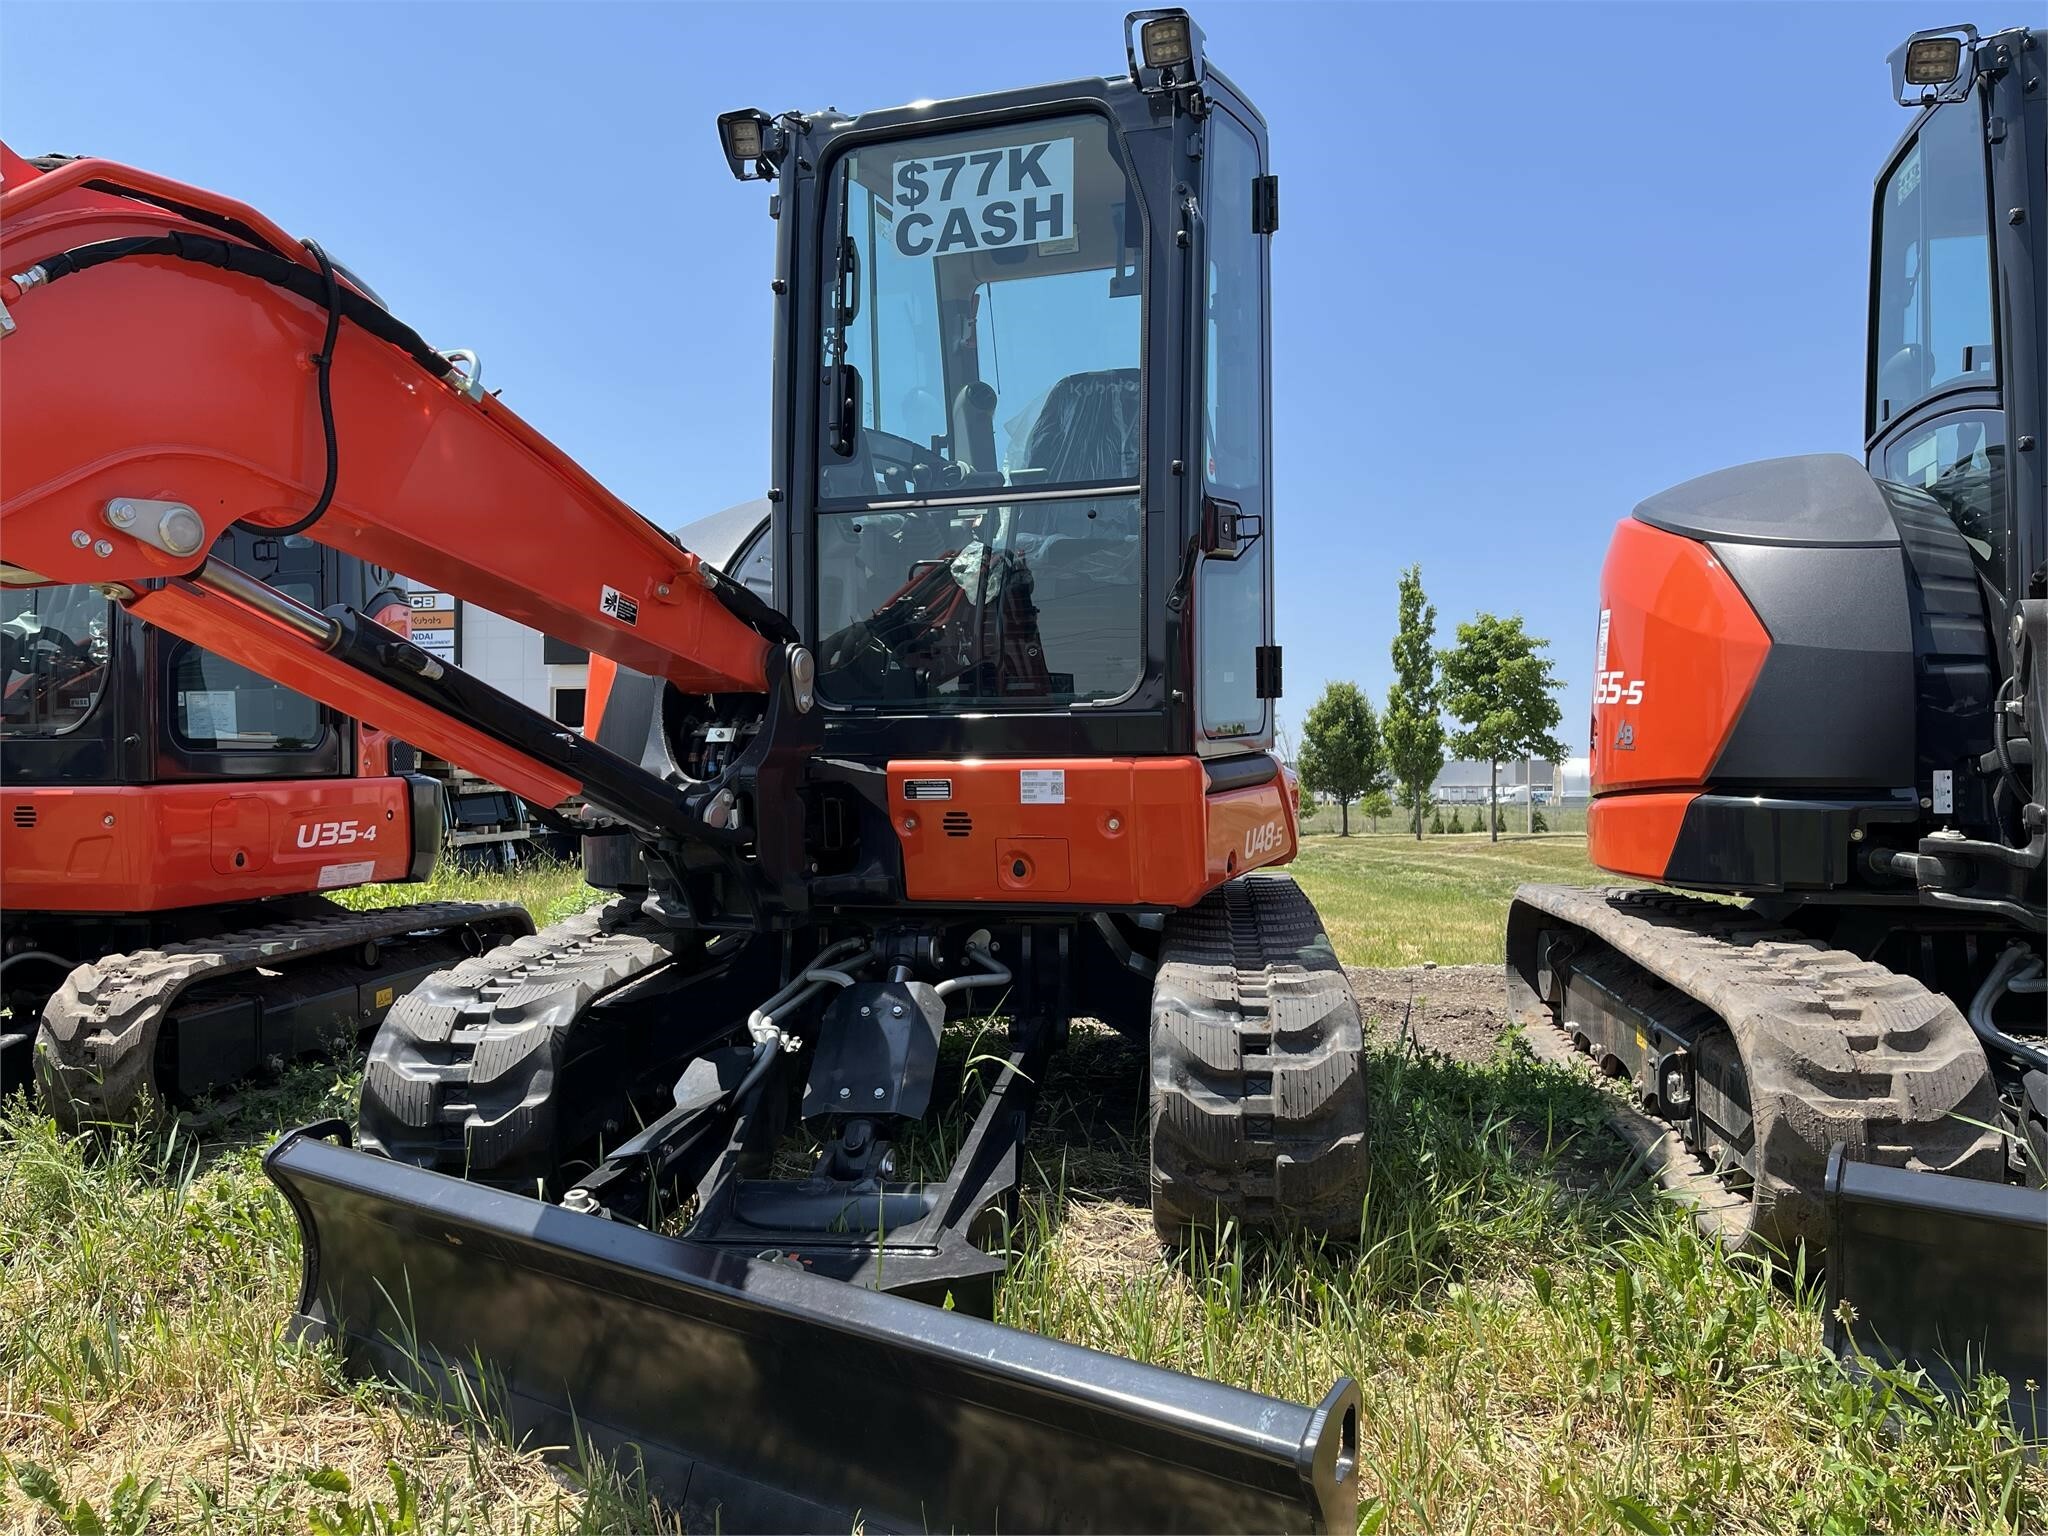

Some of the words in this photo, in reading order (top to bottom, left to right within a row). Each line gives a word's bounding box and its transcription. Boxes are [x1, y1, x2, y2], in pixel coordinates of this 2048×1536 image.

[896, 143, 1052, 211] $77K
[896, 193, 1064, 257] CASH
[408, 596, 434, 609] CB
[412, 616, 441, 625] Kubota
[412, 633, 433, 641] NDAI
[297, 821, 377, 848] U35-4
[1245, 821, 1283, 860] U48-5
